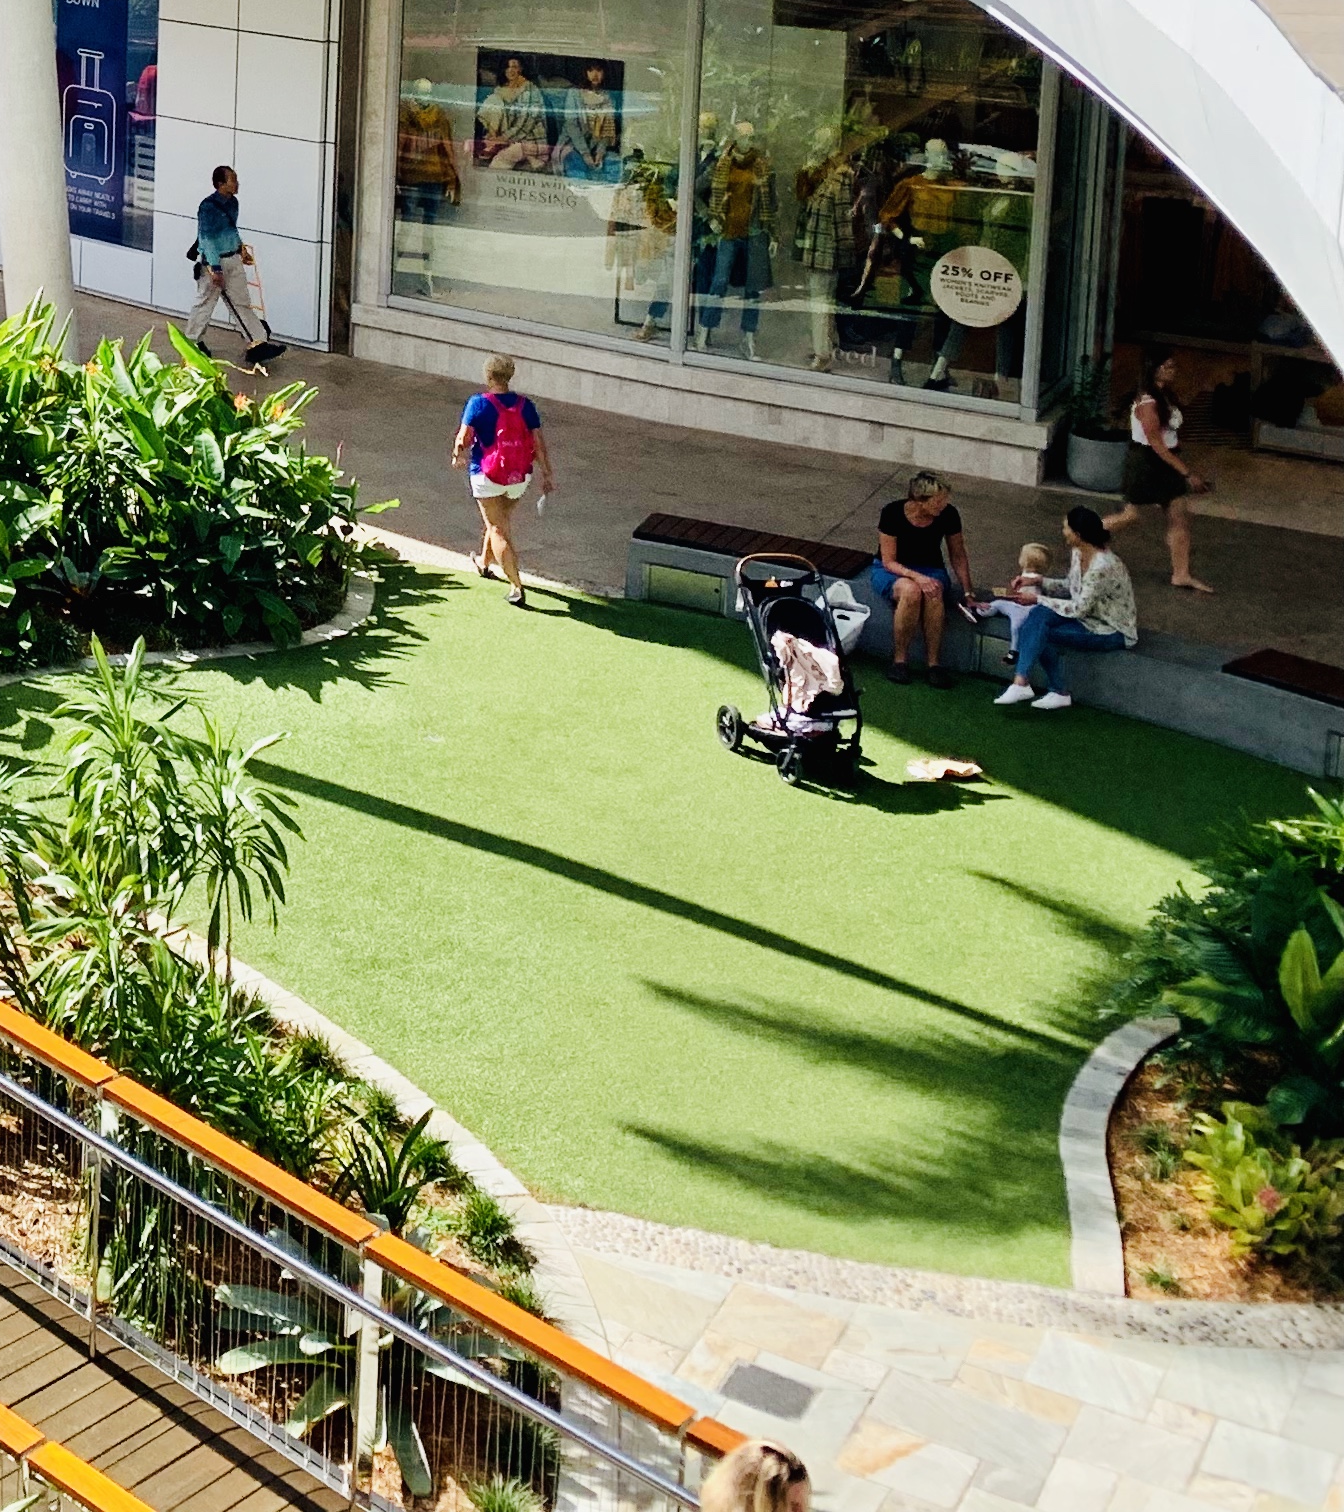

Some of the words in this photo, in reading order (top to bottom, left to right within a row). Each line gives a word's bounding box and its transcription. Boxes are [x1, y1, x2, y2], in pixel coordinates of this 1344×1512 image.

[496, 174, 535, 186] warm
[495, 186, 577, 208] DRESSING
[941, 265, 973, 278] 25%
[980, 270, 1013, 283] OFF
